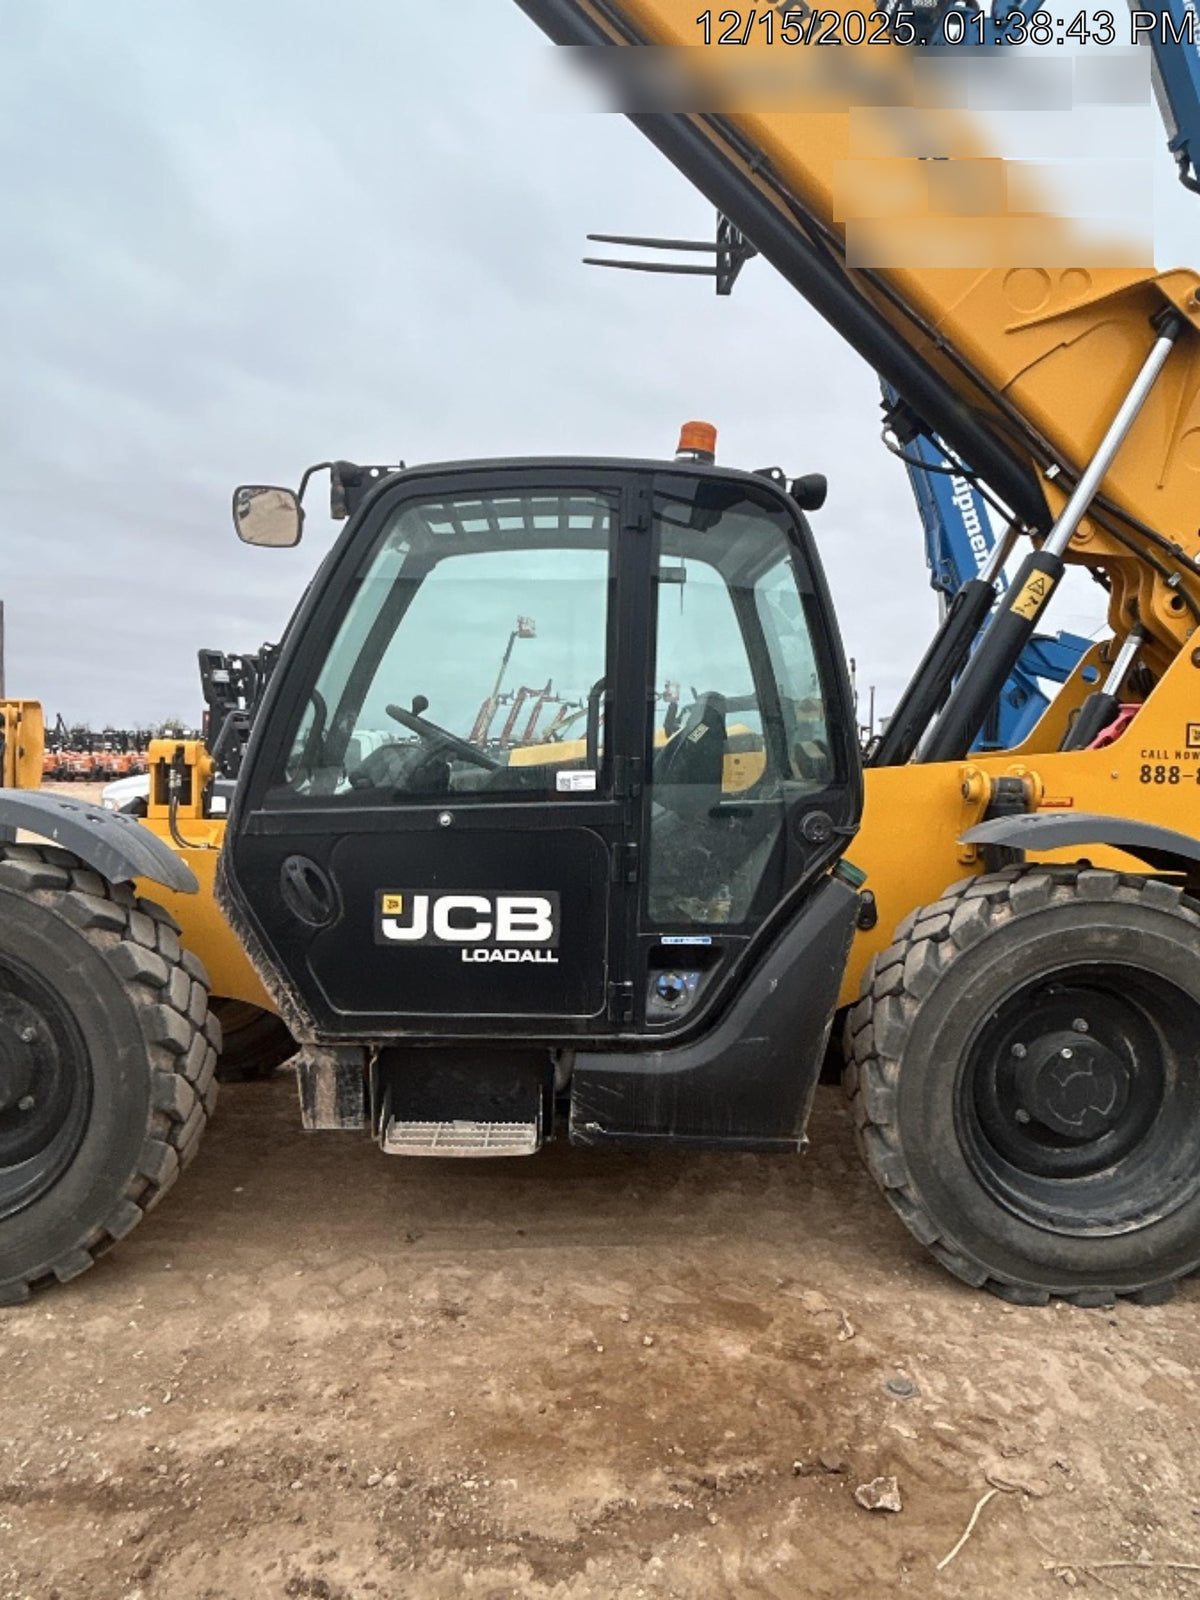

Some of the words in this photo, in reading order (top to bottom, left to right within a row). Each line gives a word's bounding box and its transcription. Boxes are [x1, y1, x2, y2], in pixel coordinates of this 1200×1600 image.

[1141, 750, 1169, 759] CALL
[1175, 751, 1200, 759] NOW
[381, 895, 553, 941] JCB
[461, 949, 559, 963] LOADALL
